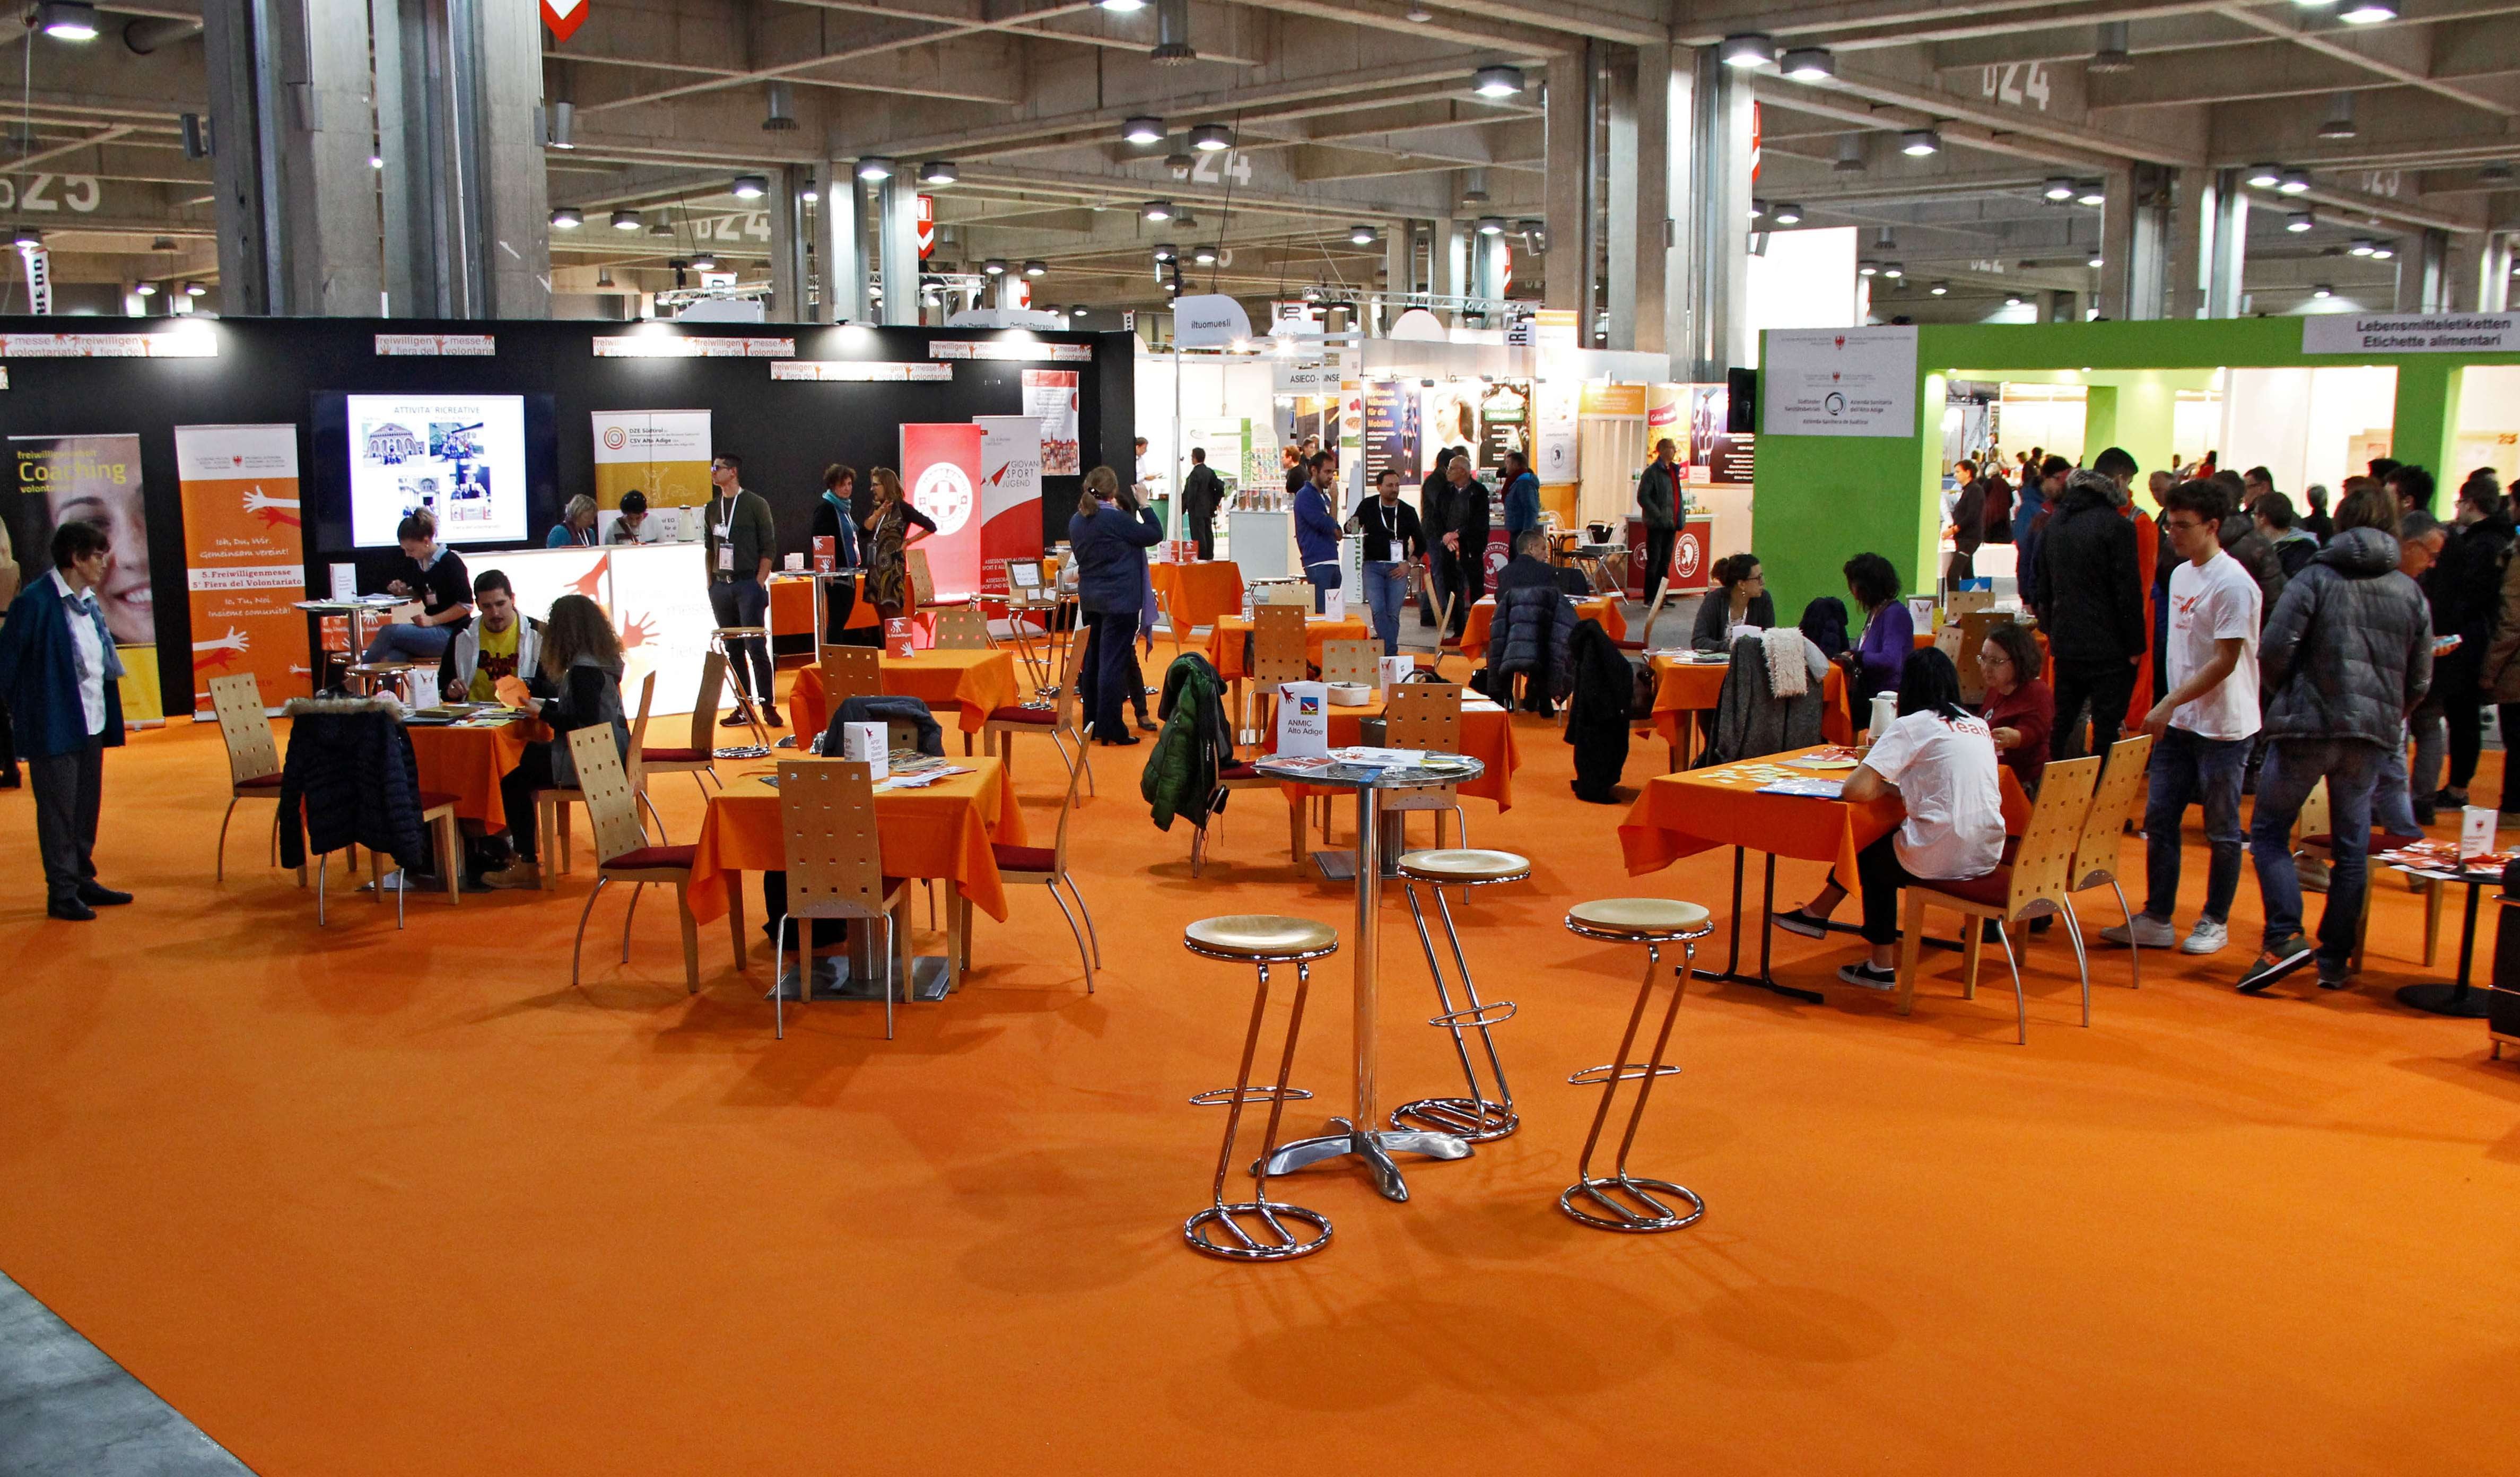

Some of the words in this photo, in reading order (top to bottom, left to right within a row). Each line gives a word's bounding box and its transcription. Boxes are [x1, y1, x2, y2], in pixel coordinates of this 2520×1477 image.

[1191, 319, 1231, 328] iltuomuesli
[2357, 319, 2512, 332] Lebensmitteletiketten
[376, 336, 432, 346] freiwilligen
[2362, 335, 2426, 347] Etichette
[2429, 334, 2501, 346] alimentari
[1290, 374, 1315, 383] ASIECO
[19, 458, 127, 485] Coaching
[1007, 468, 1033, 479] SPORT
[1002, 479, 1031, 488] JUGEND
[212, 569, 291, 579] Freiwilligenmesse
[1303, 727, 1323, 736] Adige
